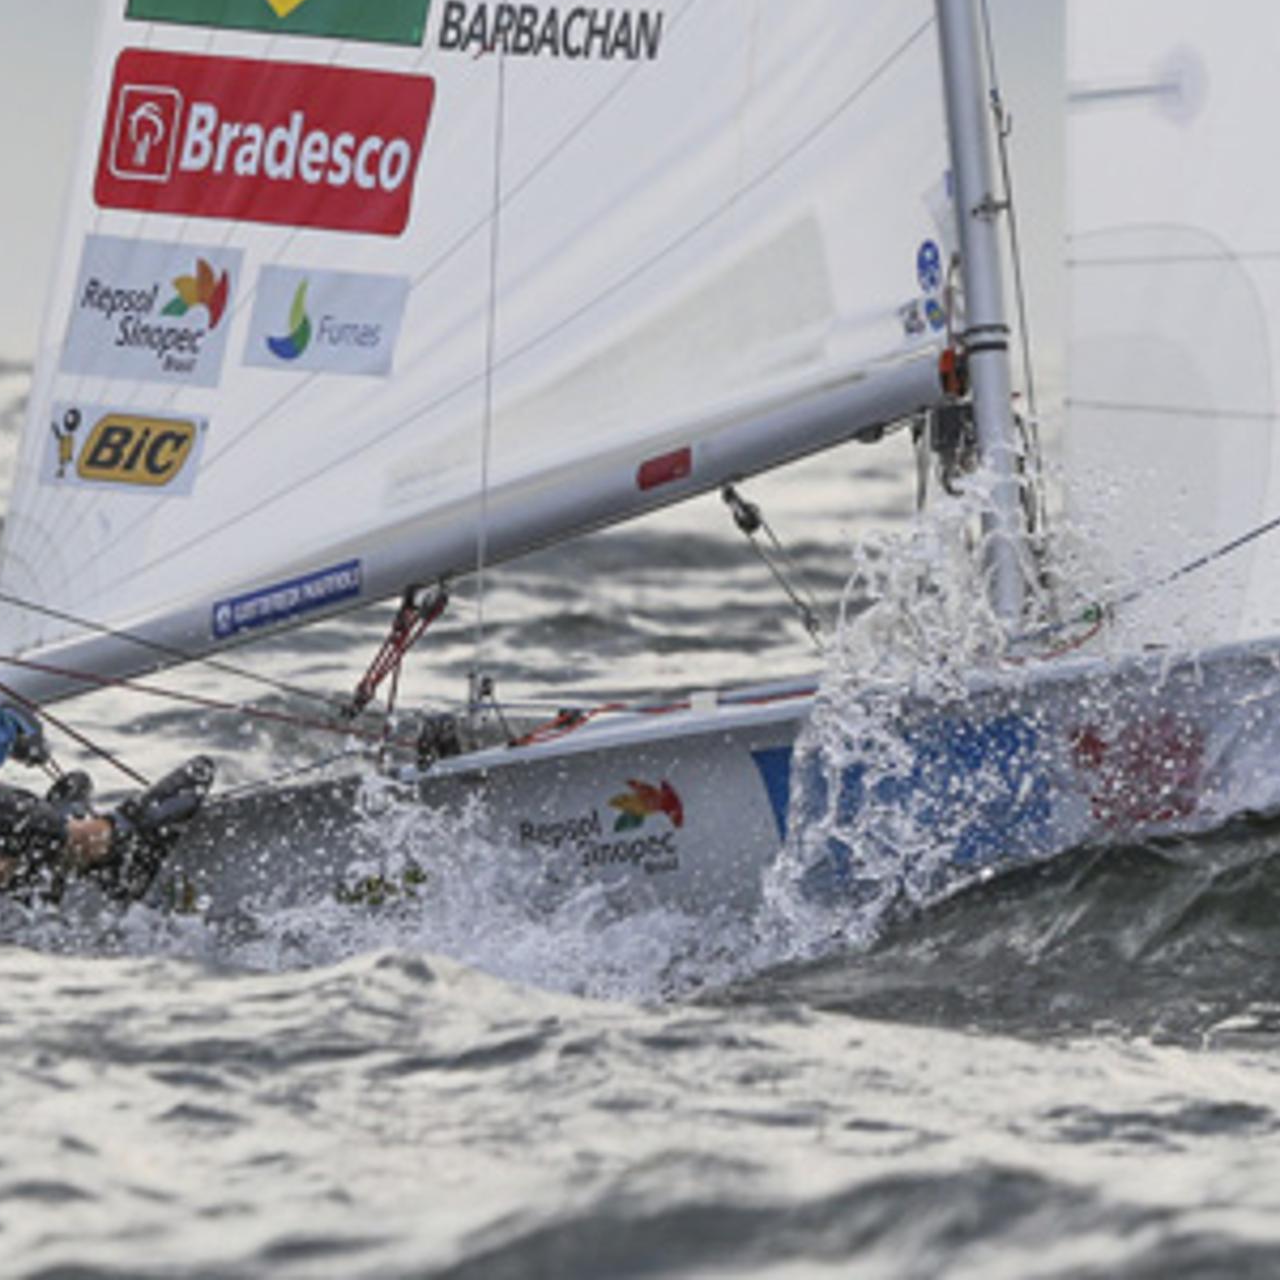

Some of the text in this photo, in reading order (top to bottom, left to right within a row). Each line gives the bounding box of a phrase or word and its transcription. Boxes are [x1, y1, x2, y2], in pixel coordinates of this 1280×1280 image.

[438, 0, 663, 61] BARBACHAN
[178, 102, 412, 191] Bradesco
[81, 277, 159, 320] Repsol
[114, 315, 205, 359] Sinopec
